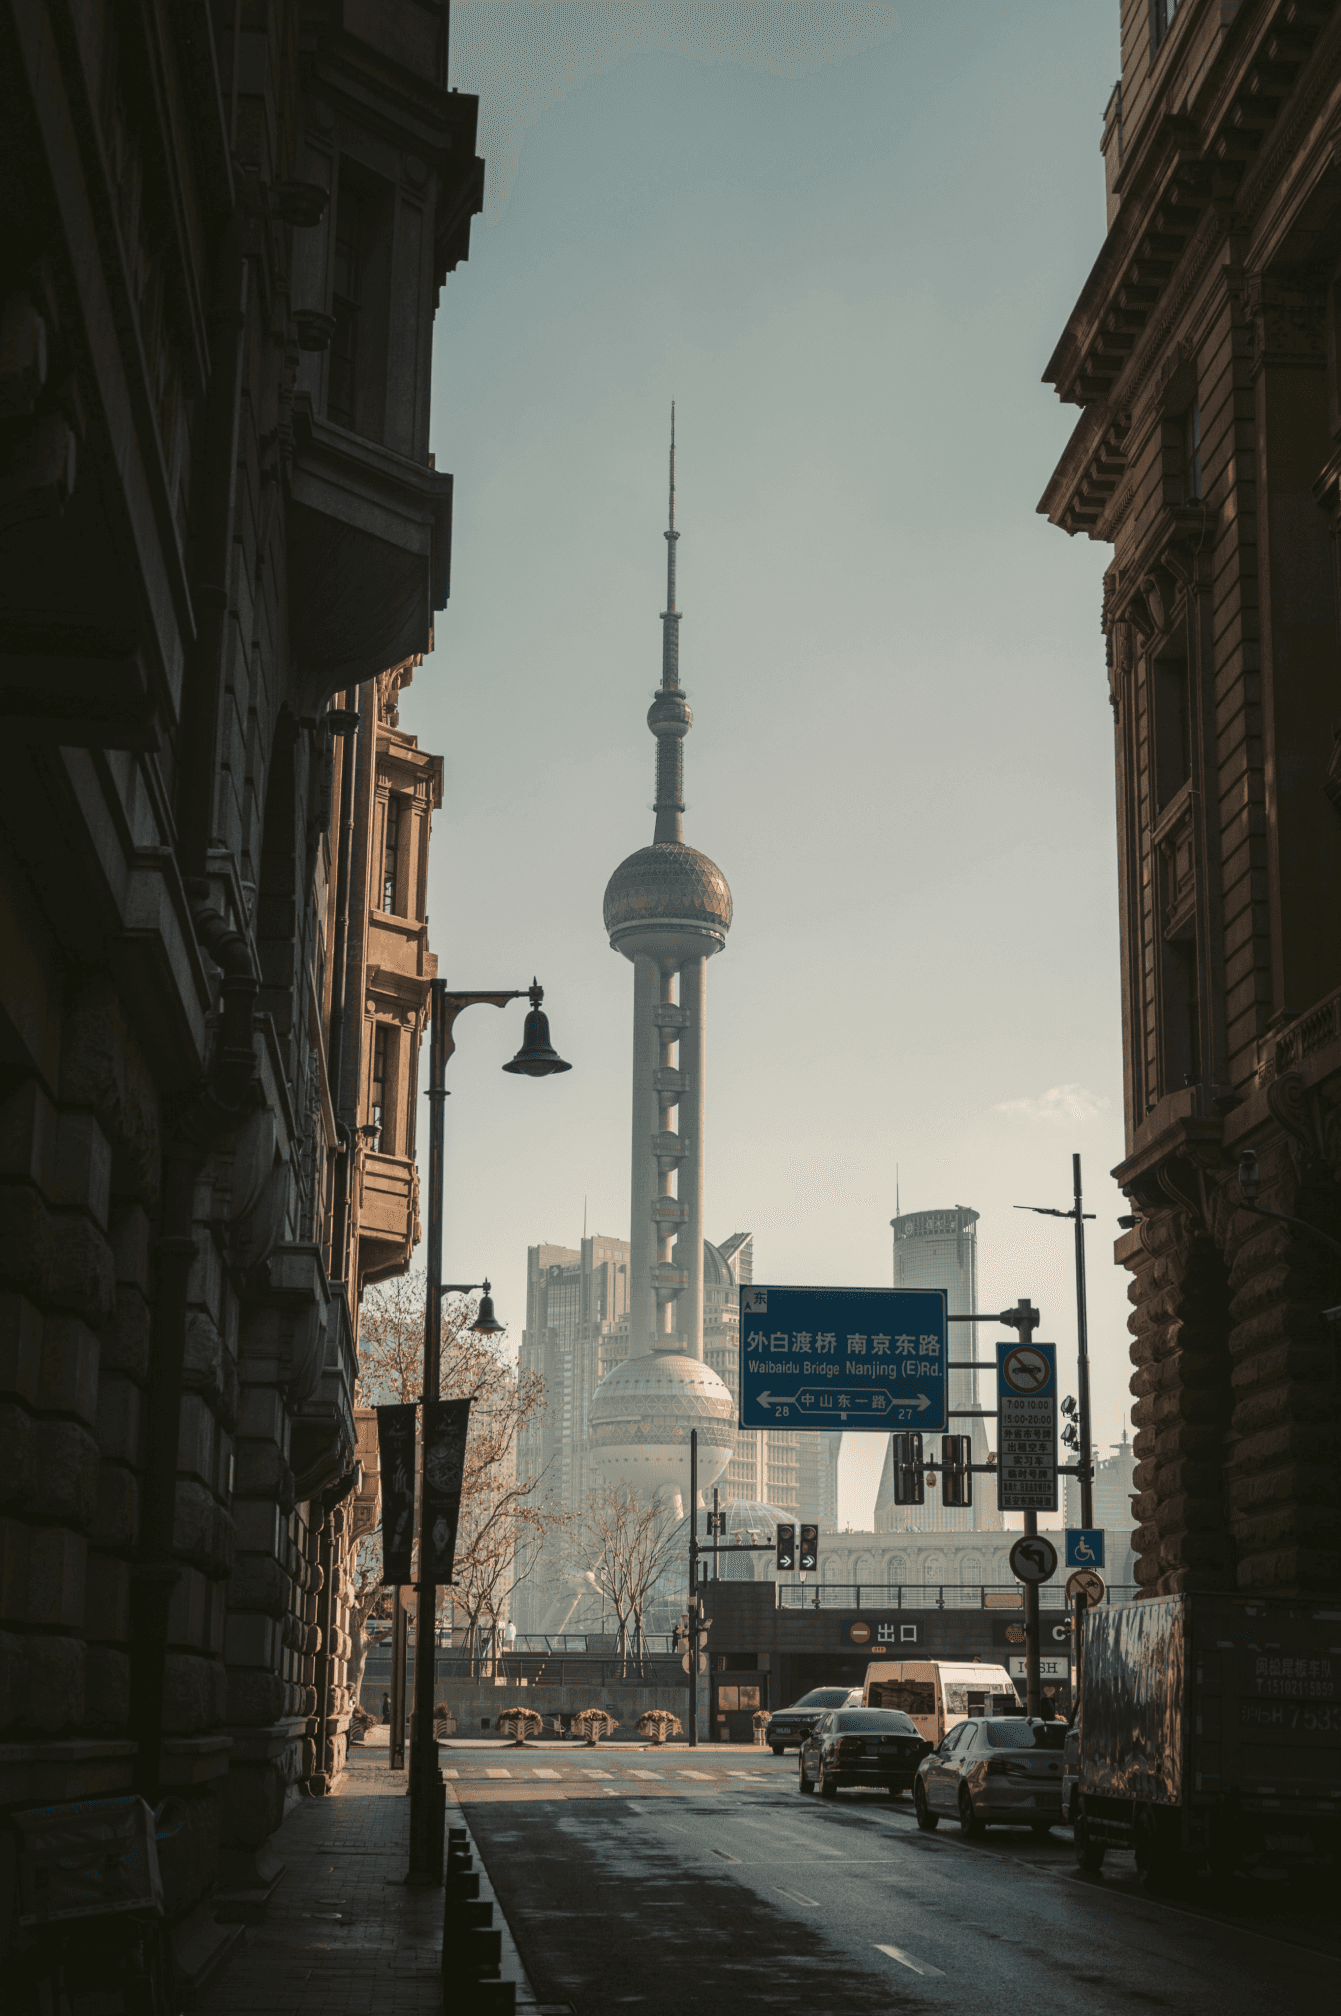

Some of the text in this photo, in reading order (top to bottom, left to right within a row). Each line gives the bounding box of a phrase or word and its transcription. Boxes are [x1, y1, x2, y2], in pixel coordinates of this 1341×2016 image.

[753, 1292, 767, 1305] 东
[746, 1331, 941, 1356] 外白渡桥 南京东路
[748, 1359, 800, 1374] Waibaidu
[803, 1360, 840, 1378] Bridge
[846, 1360, 897, 1380] Nanjing
[801, 1392, 887, 1410] 中山东一路
[775, 1406, 790, 1418] 28
[898, 1408, 913, 1420] 27
[1004, 1414, 1052, 1424] 15:00-20:00
[1004, 1428, 1052, 1439] 外省市号牌
[1007, 1442, 1048, 1453] 出租空车
[1013, 1455, 1044, 1466] 实习车
[1007, 1469, 1048, 1480] 临时号牌
[1004, 1496, 1052, 1507] 延安东路隧道
[877, 1623, 918, 1643] 出口
